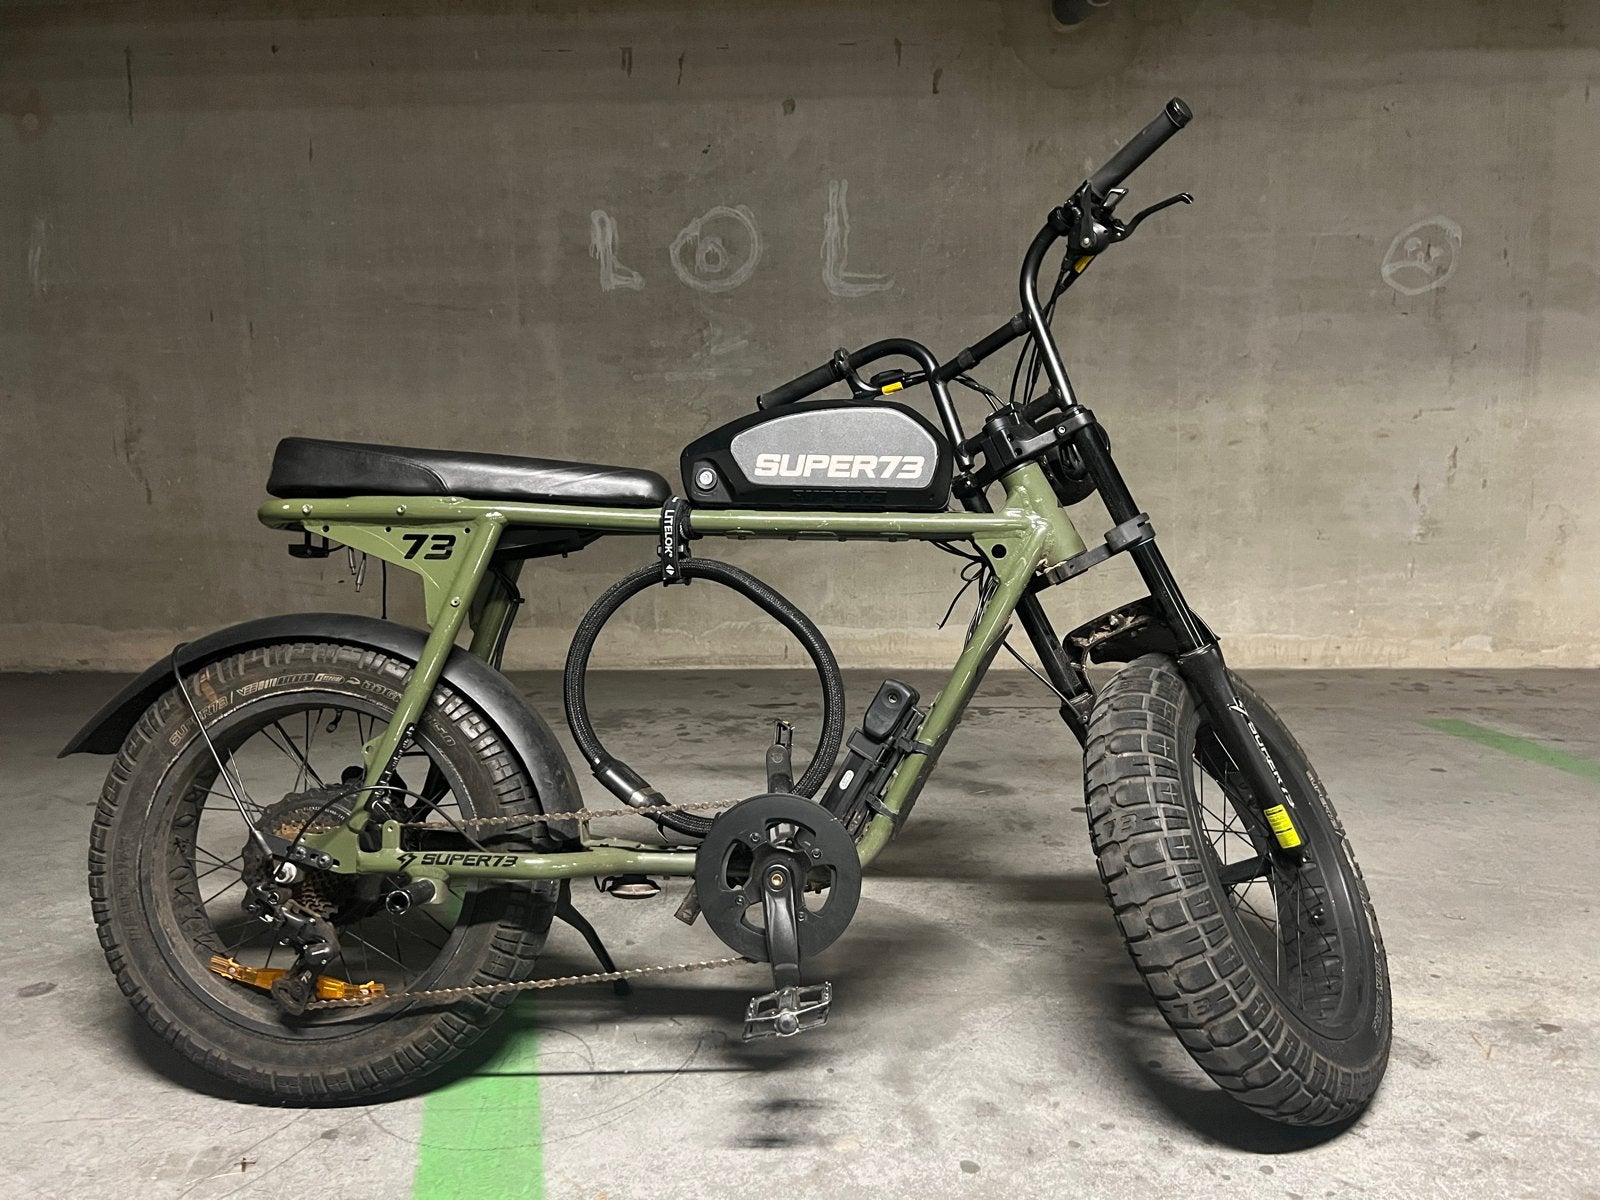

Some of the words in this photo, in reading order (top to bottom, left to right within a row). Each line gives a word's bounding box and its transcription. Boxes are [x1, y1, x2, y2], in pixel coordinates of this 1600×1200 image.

[754, 453, 925, 480] SUPER73
[663, 509, 676, 556] LITELOK
[402, 533, 457, 560] 73
[420, 853, 519, 868] SUPER73
